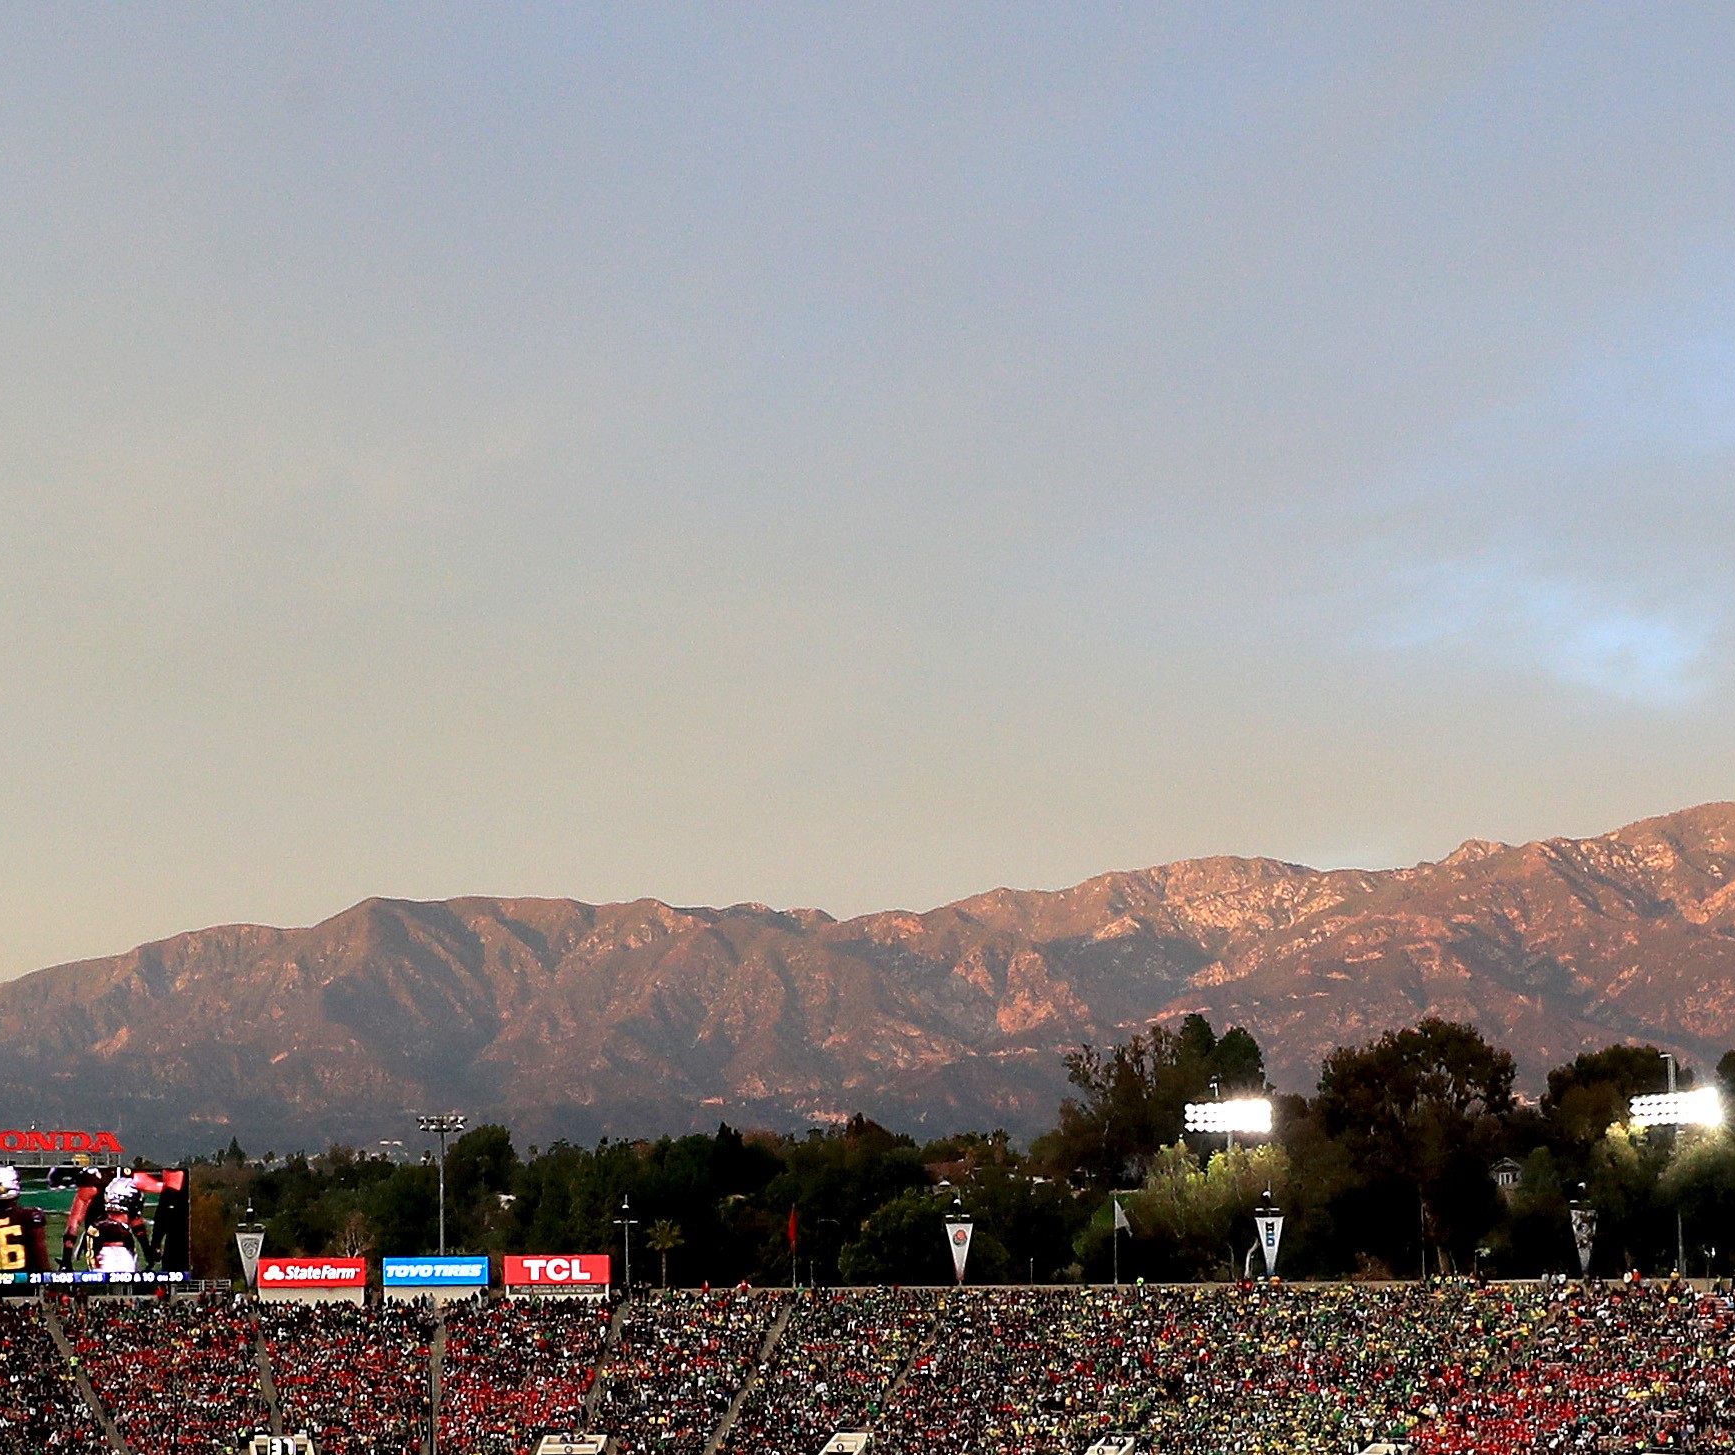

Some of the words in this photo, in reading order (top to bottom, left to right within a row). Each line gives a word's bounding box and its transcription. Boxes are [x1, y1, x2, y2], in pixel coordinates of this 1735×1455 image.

[284, 1265, 356, 1280] StateFarm
[385, 1265, 433, 1278] TOYO
[433, 1264, 483, 1277] TIRES
[523, 1258, 591, 1281] TCL
